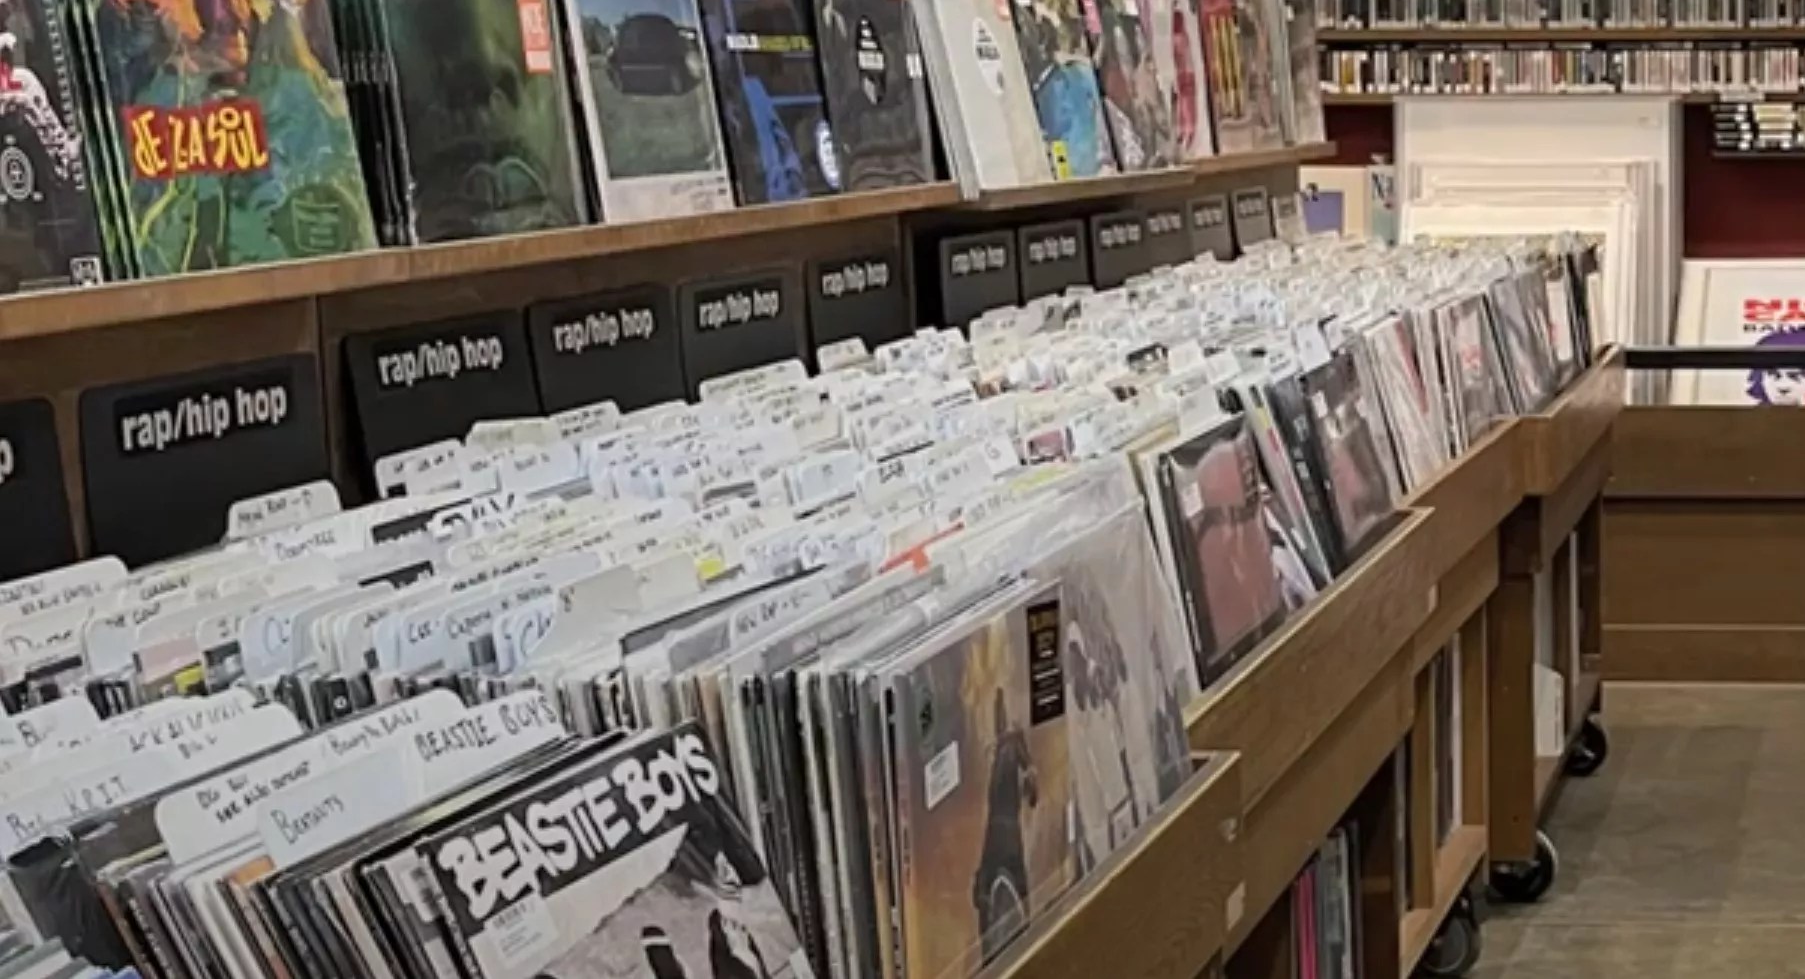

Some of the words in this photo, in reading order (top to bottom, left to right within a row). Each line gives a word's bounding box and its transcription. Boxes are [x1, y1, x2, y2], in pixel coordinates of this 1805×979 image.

[866, 261, 891, 289] hop
[752, 289, 781, 318] hop
[552, 312, 620, 354] rap/hip
[619, 307, 655, 340] hop
[378, 342, 460, 388] rap/hip
[461, 334, 504, 372] hop
[122, 389, 231, 452] rap/hip
[235, 383, 288, 426] hop
[414, 714, 499, 763] BEASTIE
[437, 776, 632, 920] BEASTIE
[611, 734, 720, 835] BOYS
